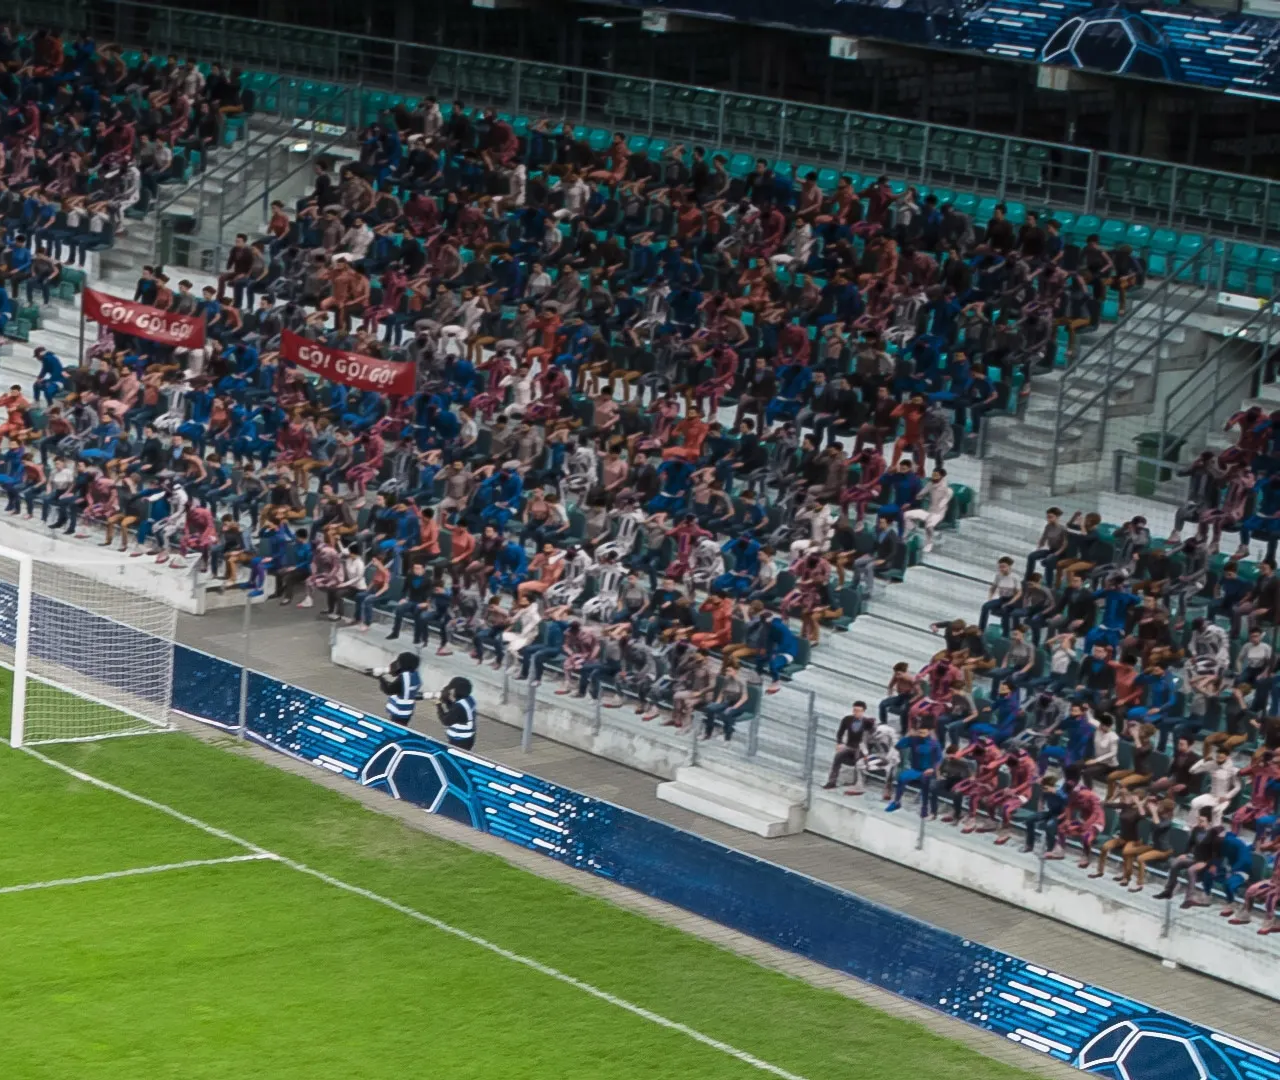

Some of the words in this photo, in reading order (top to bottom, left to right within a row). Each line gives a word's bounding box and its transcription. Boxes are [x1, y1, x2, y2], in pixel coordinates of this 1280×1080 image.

[100, 302, 135, 323] GO!
[136, 313, 166, 333] GO!
[170, 321, 194, 340] GO!
[298, 345, 331, 368] GO!
[335, 358, 369, 380] GO!
[369, 366, 397, 386] GO!
